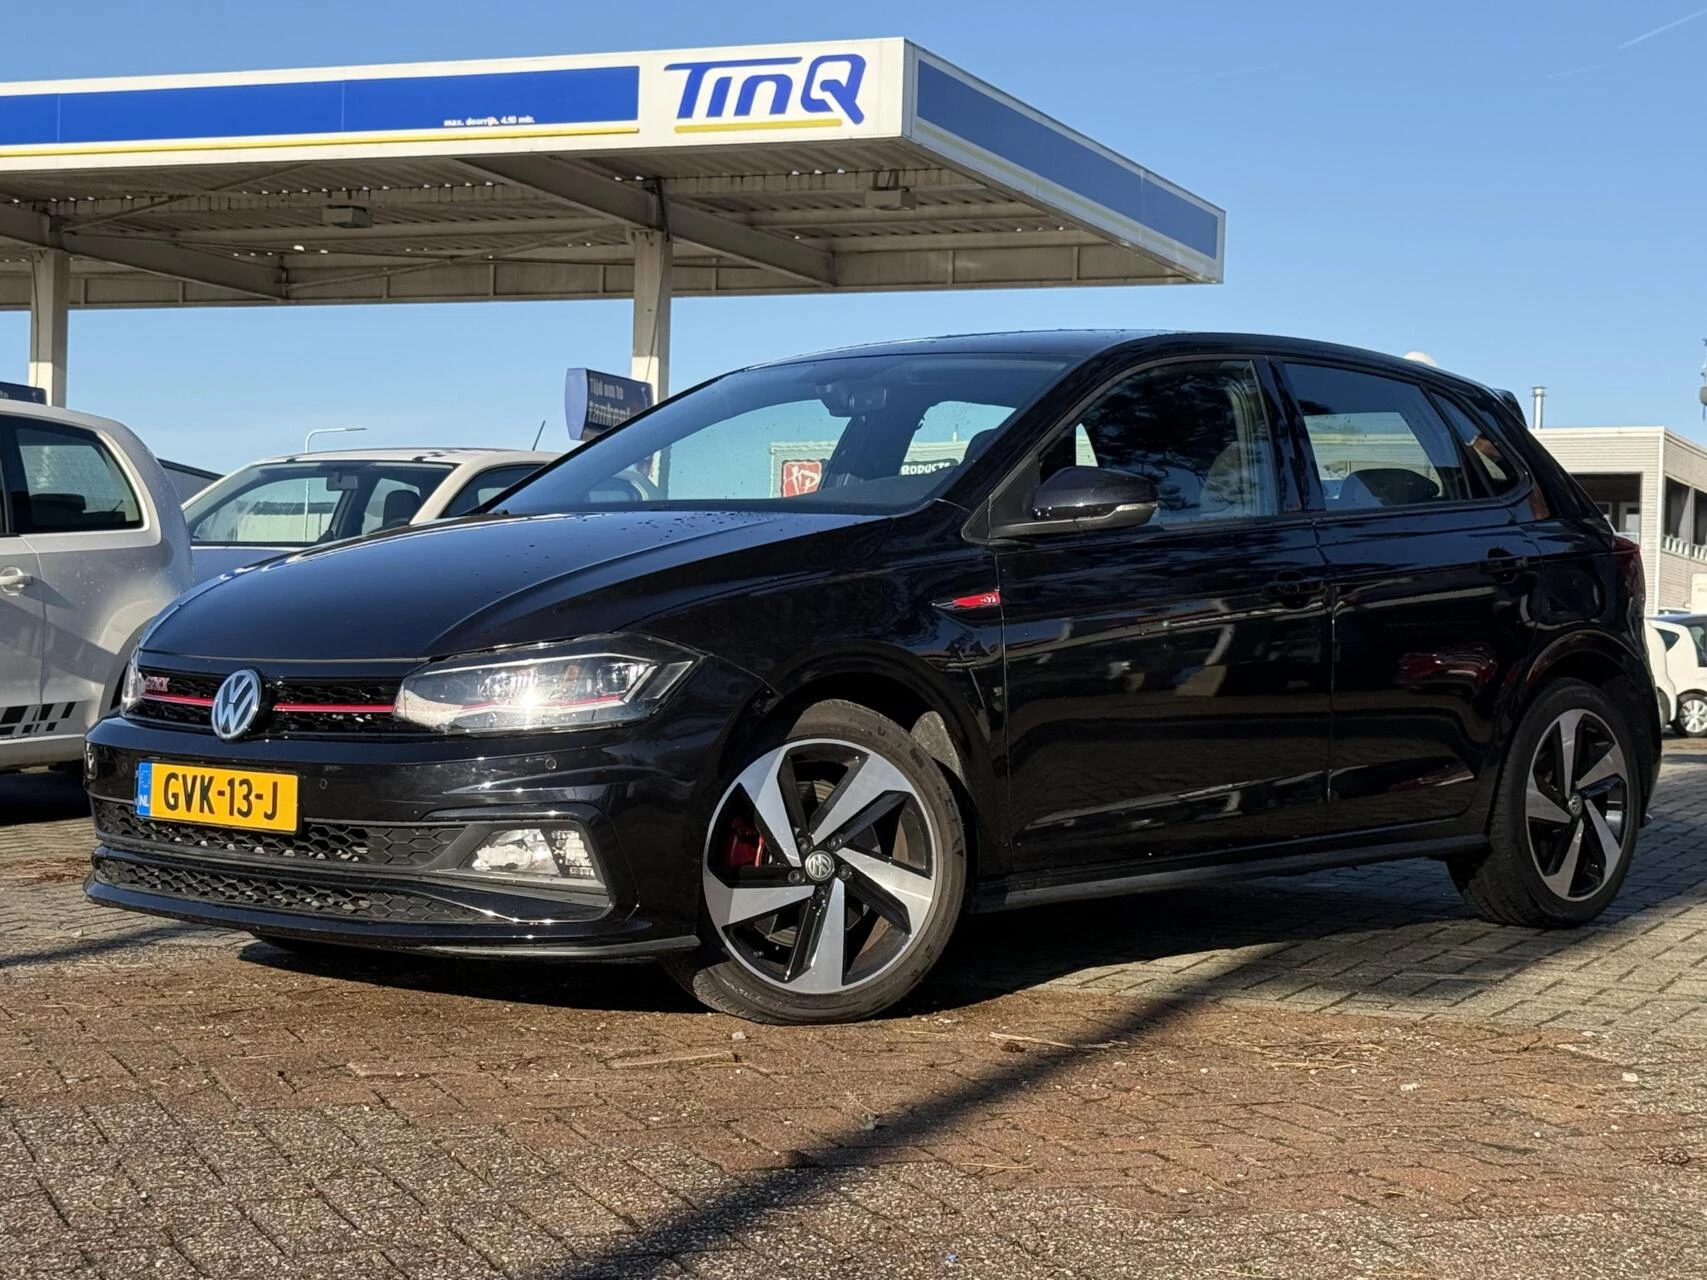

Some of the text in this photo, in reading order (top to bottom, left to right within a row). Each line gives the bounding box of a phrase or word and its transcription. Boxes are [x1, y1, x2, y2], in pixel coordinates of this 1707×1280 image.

[664, 53, 867, 125] TinQ
[444, 119, 464, 127] max.
[589, 378, 603, 396] Tijd
[139, 794, 149, 807] NL
[163, 771, 278, 821] GVK-13-J
